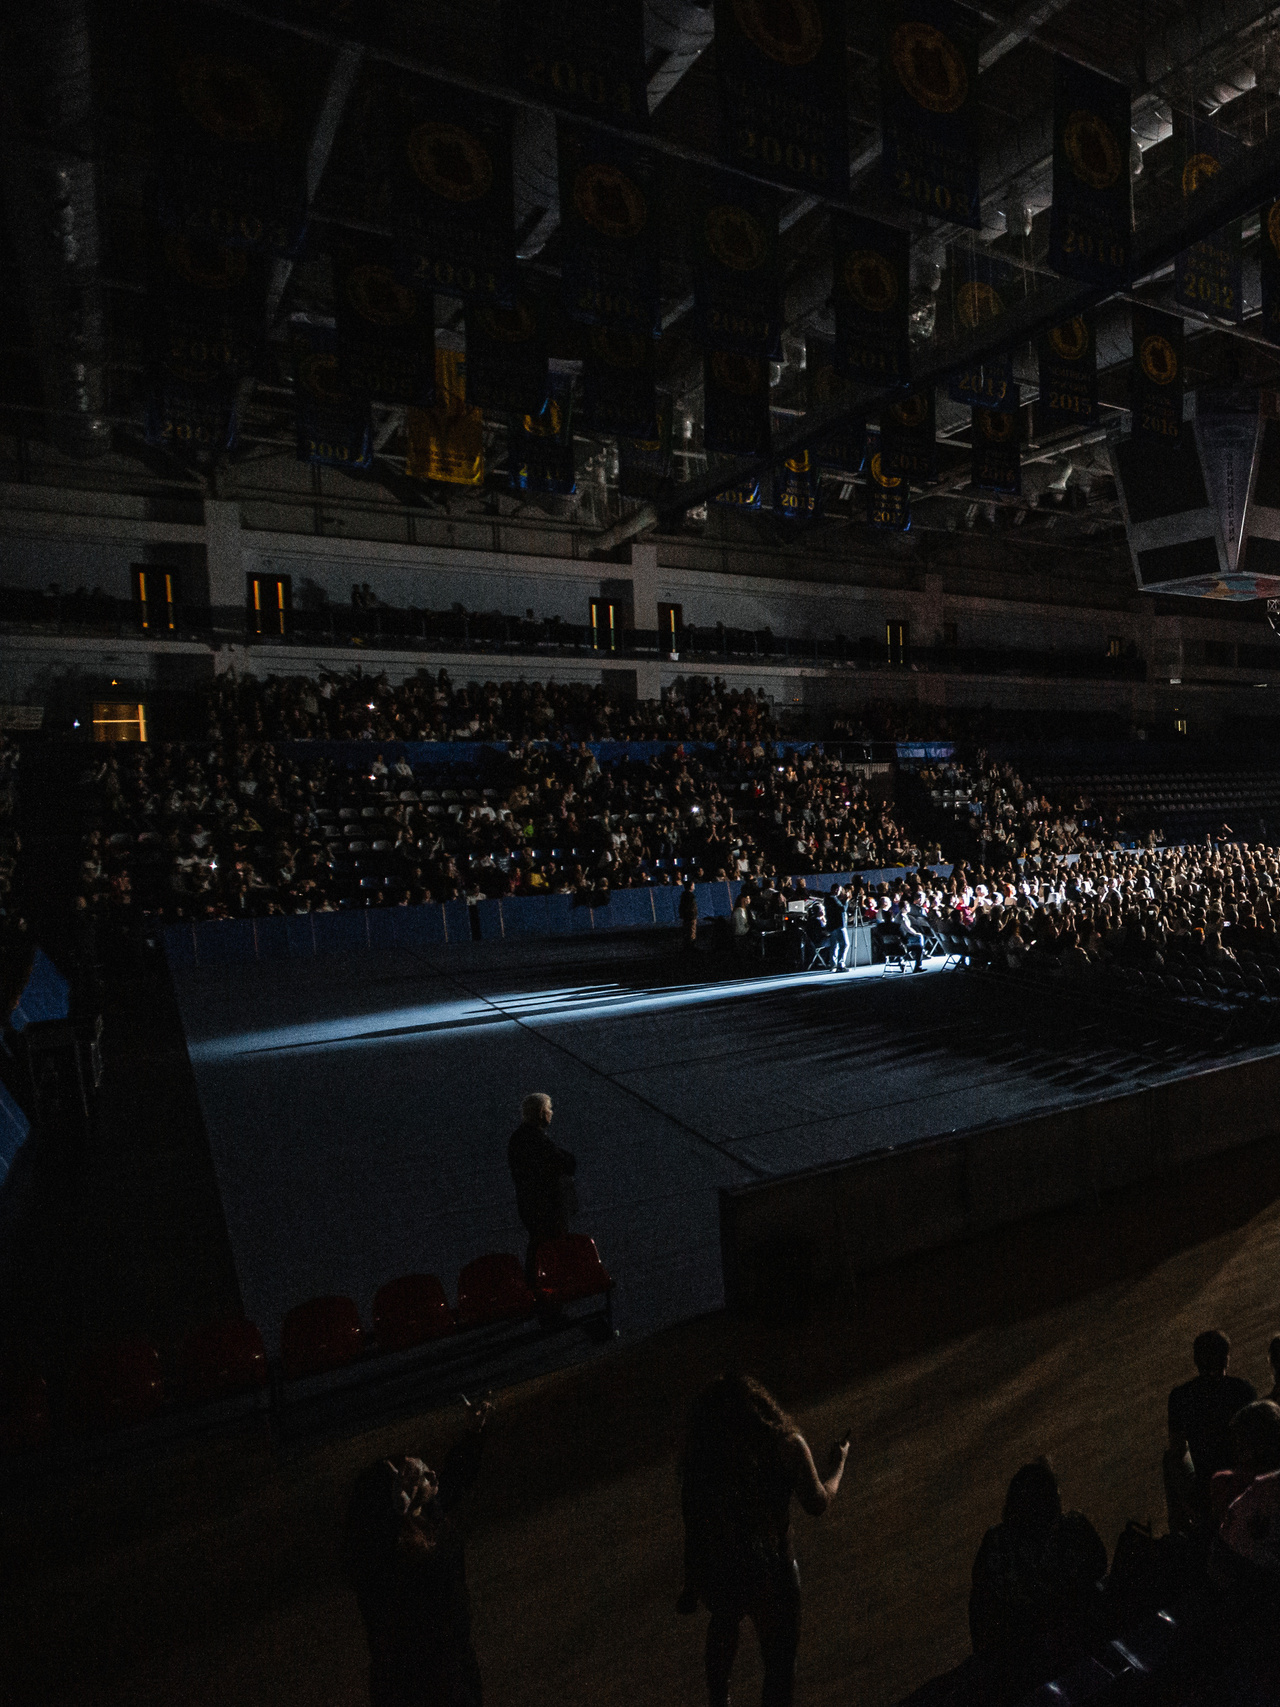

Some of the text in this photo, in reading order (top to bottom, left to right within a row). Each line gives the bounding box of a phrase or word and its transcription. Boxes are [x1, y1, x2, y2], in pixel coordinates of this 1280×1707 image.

[736, 128, 828, 180] 2006
[893, 168, 971, 217] 2008
[1183, 273, 1235, 310] 2012
[1049, 391, 1092, 415] 2015
[1141, 412, 1180, 437] 2016
[780, 493, 816, 511] 2015
[872, 510, 906, 525] 2017
